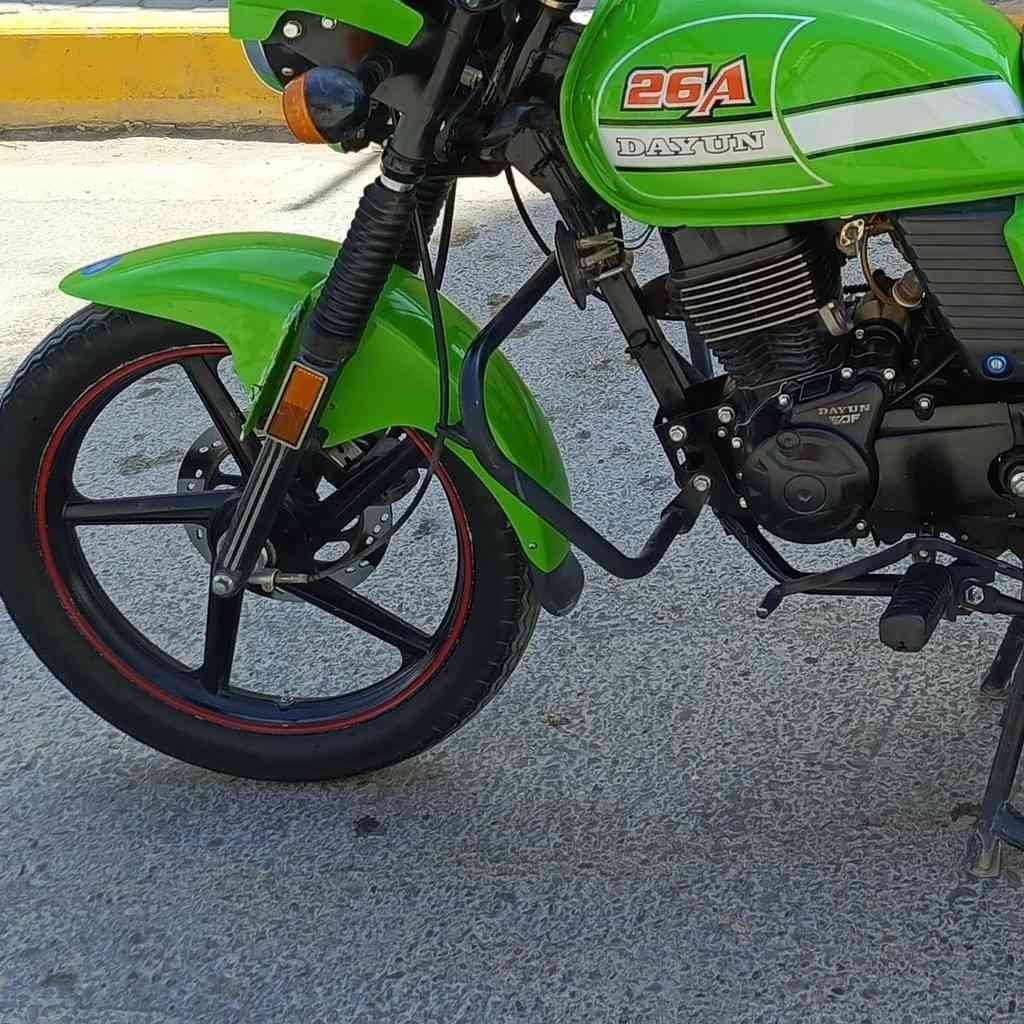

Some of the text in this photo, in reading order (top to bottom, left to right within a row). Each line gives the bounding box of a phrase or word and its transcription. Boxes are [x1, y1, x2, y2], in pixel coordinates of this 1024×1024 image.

[621, 56, 755, 120] 26A
[616, 130, 765, 157] DAYUN
[817, 403, 870, 415] DAYUN
